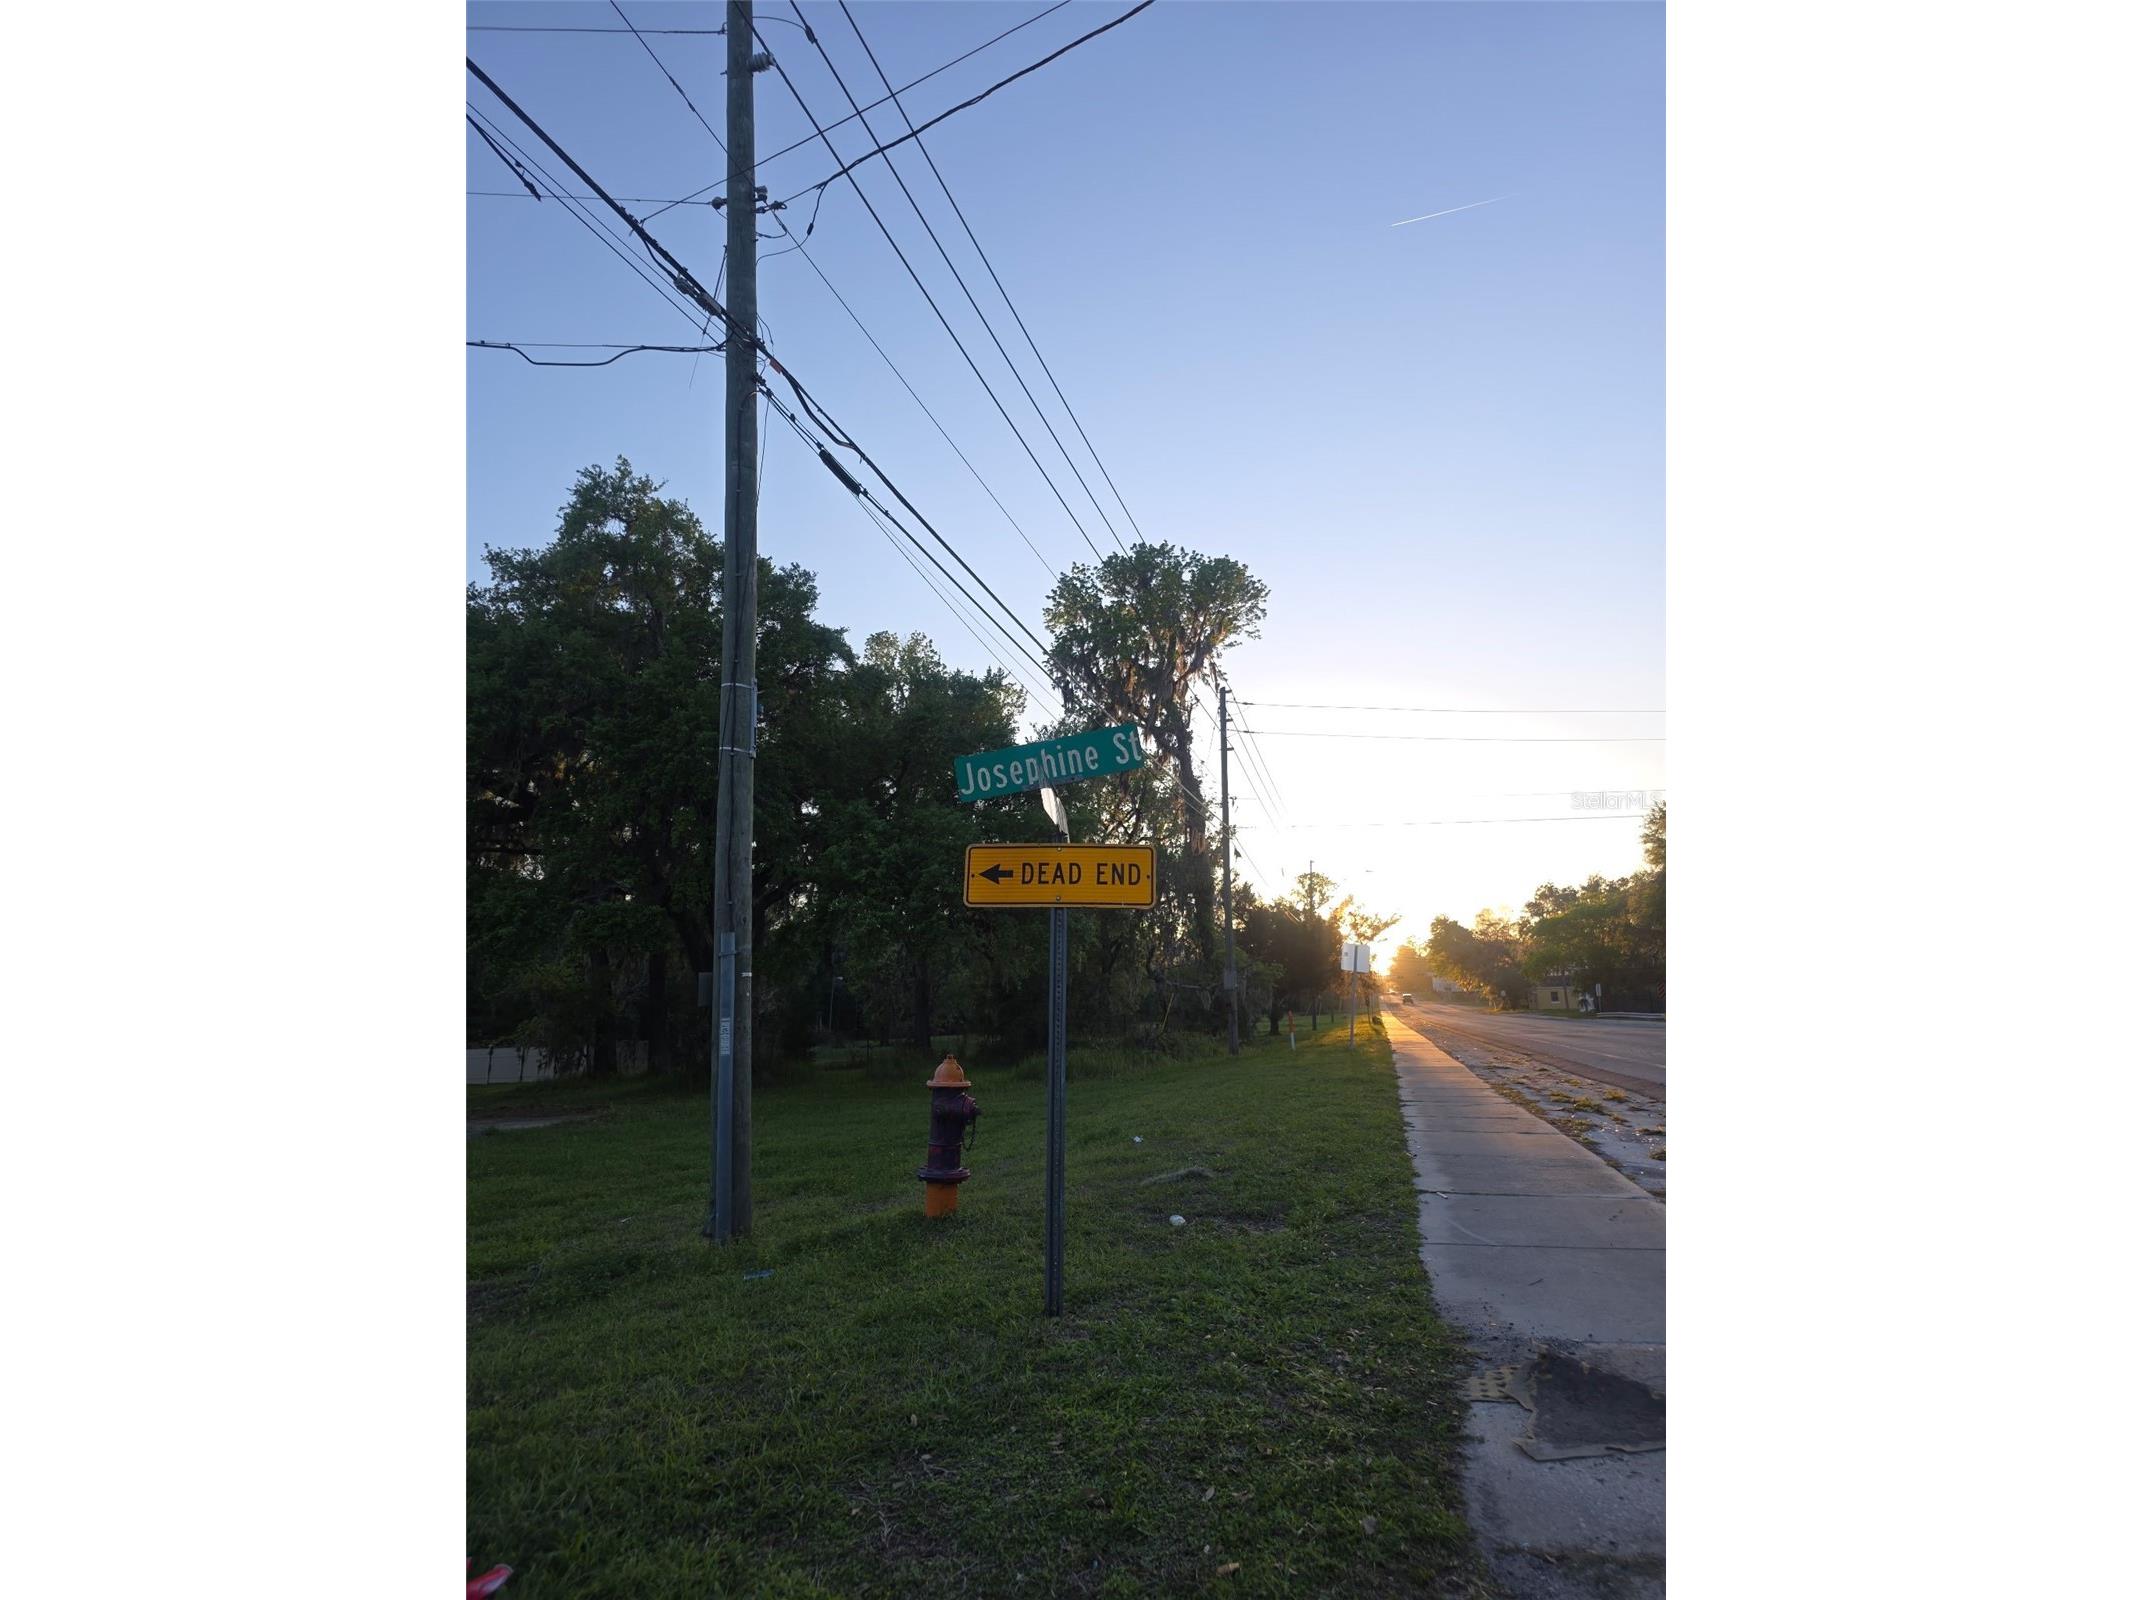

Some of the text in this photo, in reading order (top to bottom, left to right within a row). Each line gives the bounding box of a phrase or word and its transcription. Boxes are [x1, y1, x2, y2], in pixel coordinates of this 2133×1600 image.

[961, 731, 1142, 795] Josephine St
[1021, 862, 1141, 886] DEAD END
